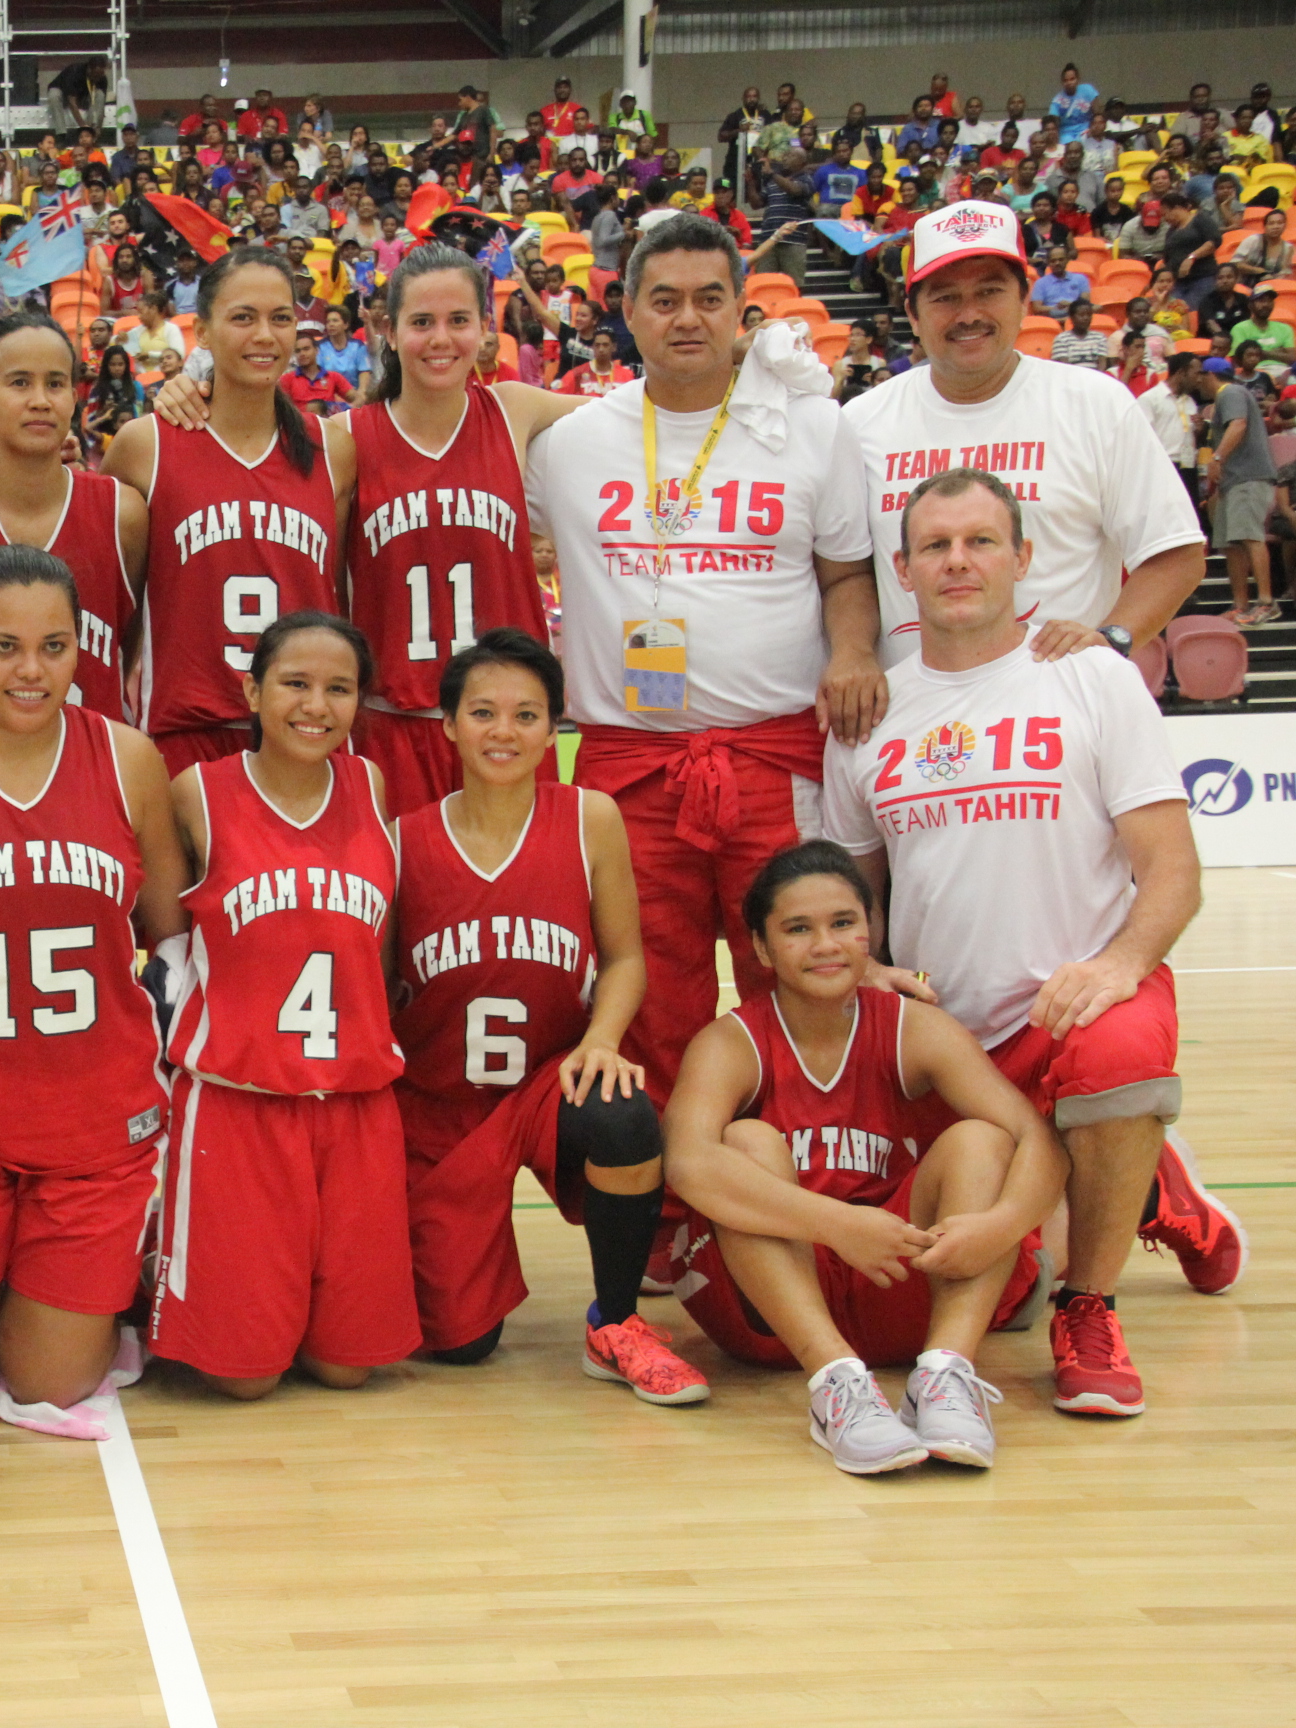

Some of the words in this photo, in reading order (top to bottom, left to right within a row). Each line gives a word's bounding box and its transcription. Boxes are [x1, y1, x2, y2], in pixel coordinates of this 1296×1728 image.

[932, 213, 1004, 232] TAHITI
[885, 449, 951, 482] TEAM
[960, 441, 1046, 473] TAHITI
[174, 500, 242, 566] TEAM
[249, 500, 328, 575] TAHITI
[362, 489, 429, 557] TEAM
[436, 488, 517, 552] TAHITI
[603, 553, 672, 578] TEAM
[678, 550, 774, 575] TAHITI
[222, 574, 280, 672] 9
[405, 561, 478, 662] 11
[877, 802, 948, 838] TEAM
[954, 792, 1061, 824] TAHITI
[25, 840, 125, 907] TAHITI
[222, 867, 298, 937] TEAM
[306, 867, 388, 937] TAHITI
[411, 919, 482, 985] TEAM
[491, 915, 581, 973] TAHITI
[276, 951, 339, 1060] 4
[465, 996, 528, 1086] 6
[821, 1126, 894, 1180] TAHITI
